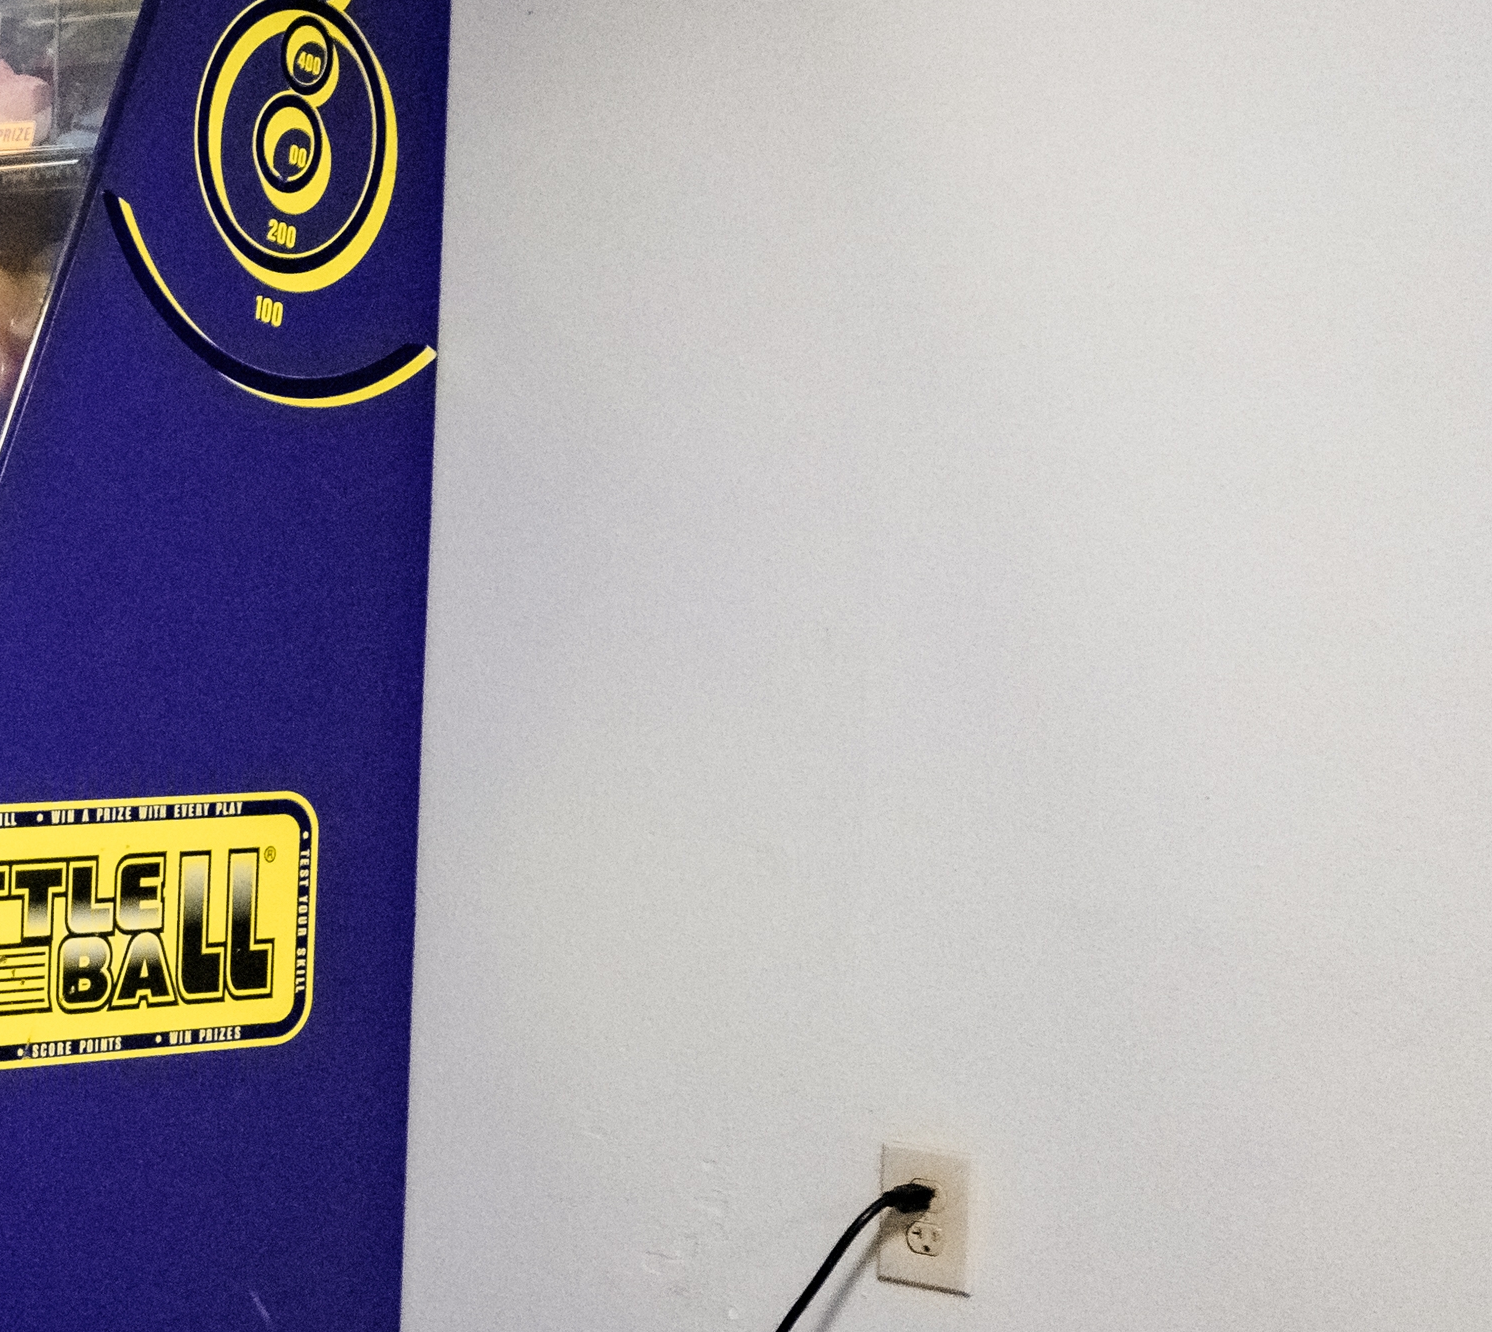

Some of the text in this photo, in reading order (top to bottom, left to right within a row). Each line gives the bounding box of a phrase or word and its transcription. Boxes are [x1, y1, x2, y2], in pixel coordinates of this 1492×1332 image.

[296, 51, 323, 76] 400
[267, 218, 297, 250] 200
[255, 295, 283, 328] 100
[50, 801, 243, 825] WIN A PRIZE WITH EVERY PLAY
[56, 846, 276, 1014] BALL
[294, 849, 311, 993] TEST YOUR SKILL
[31, 1037, 123, 1058] SCORE POINTS
[168, 1026, 242, 1045] WIN PRIZES
